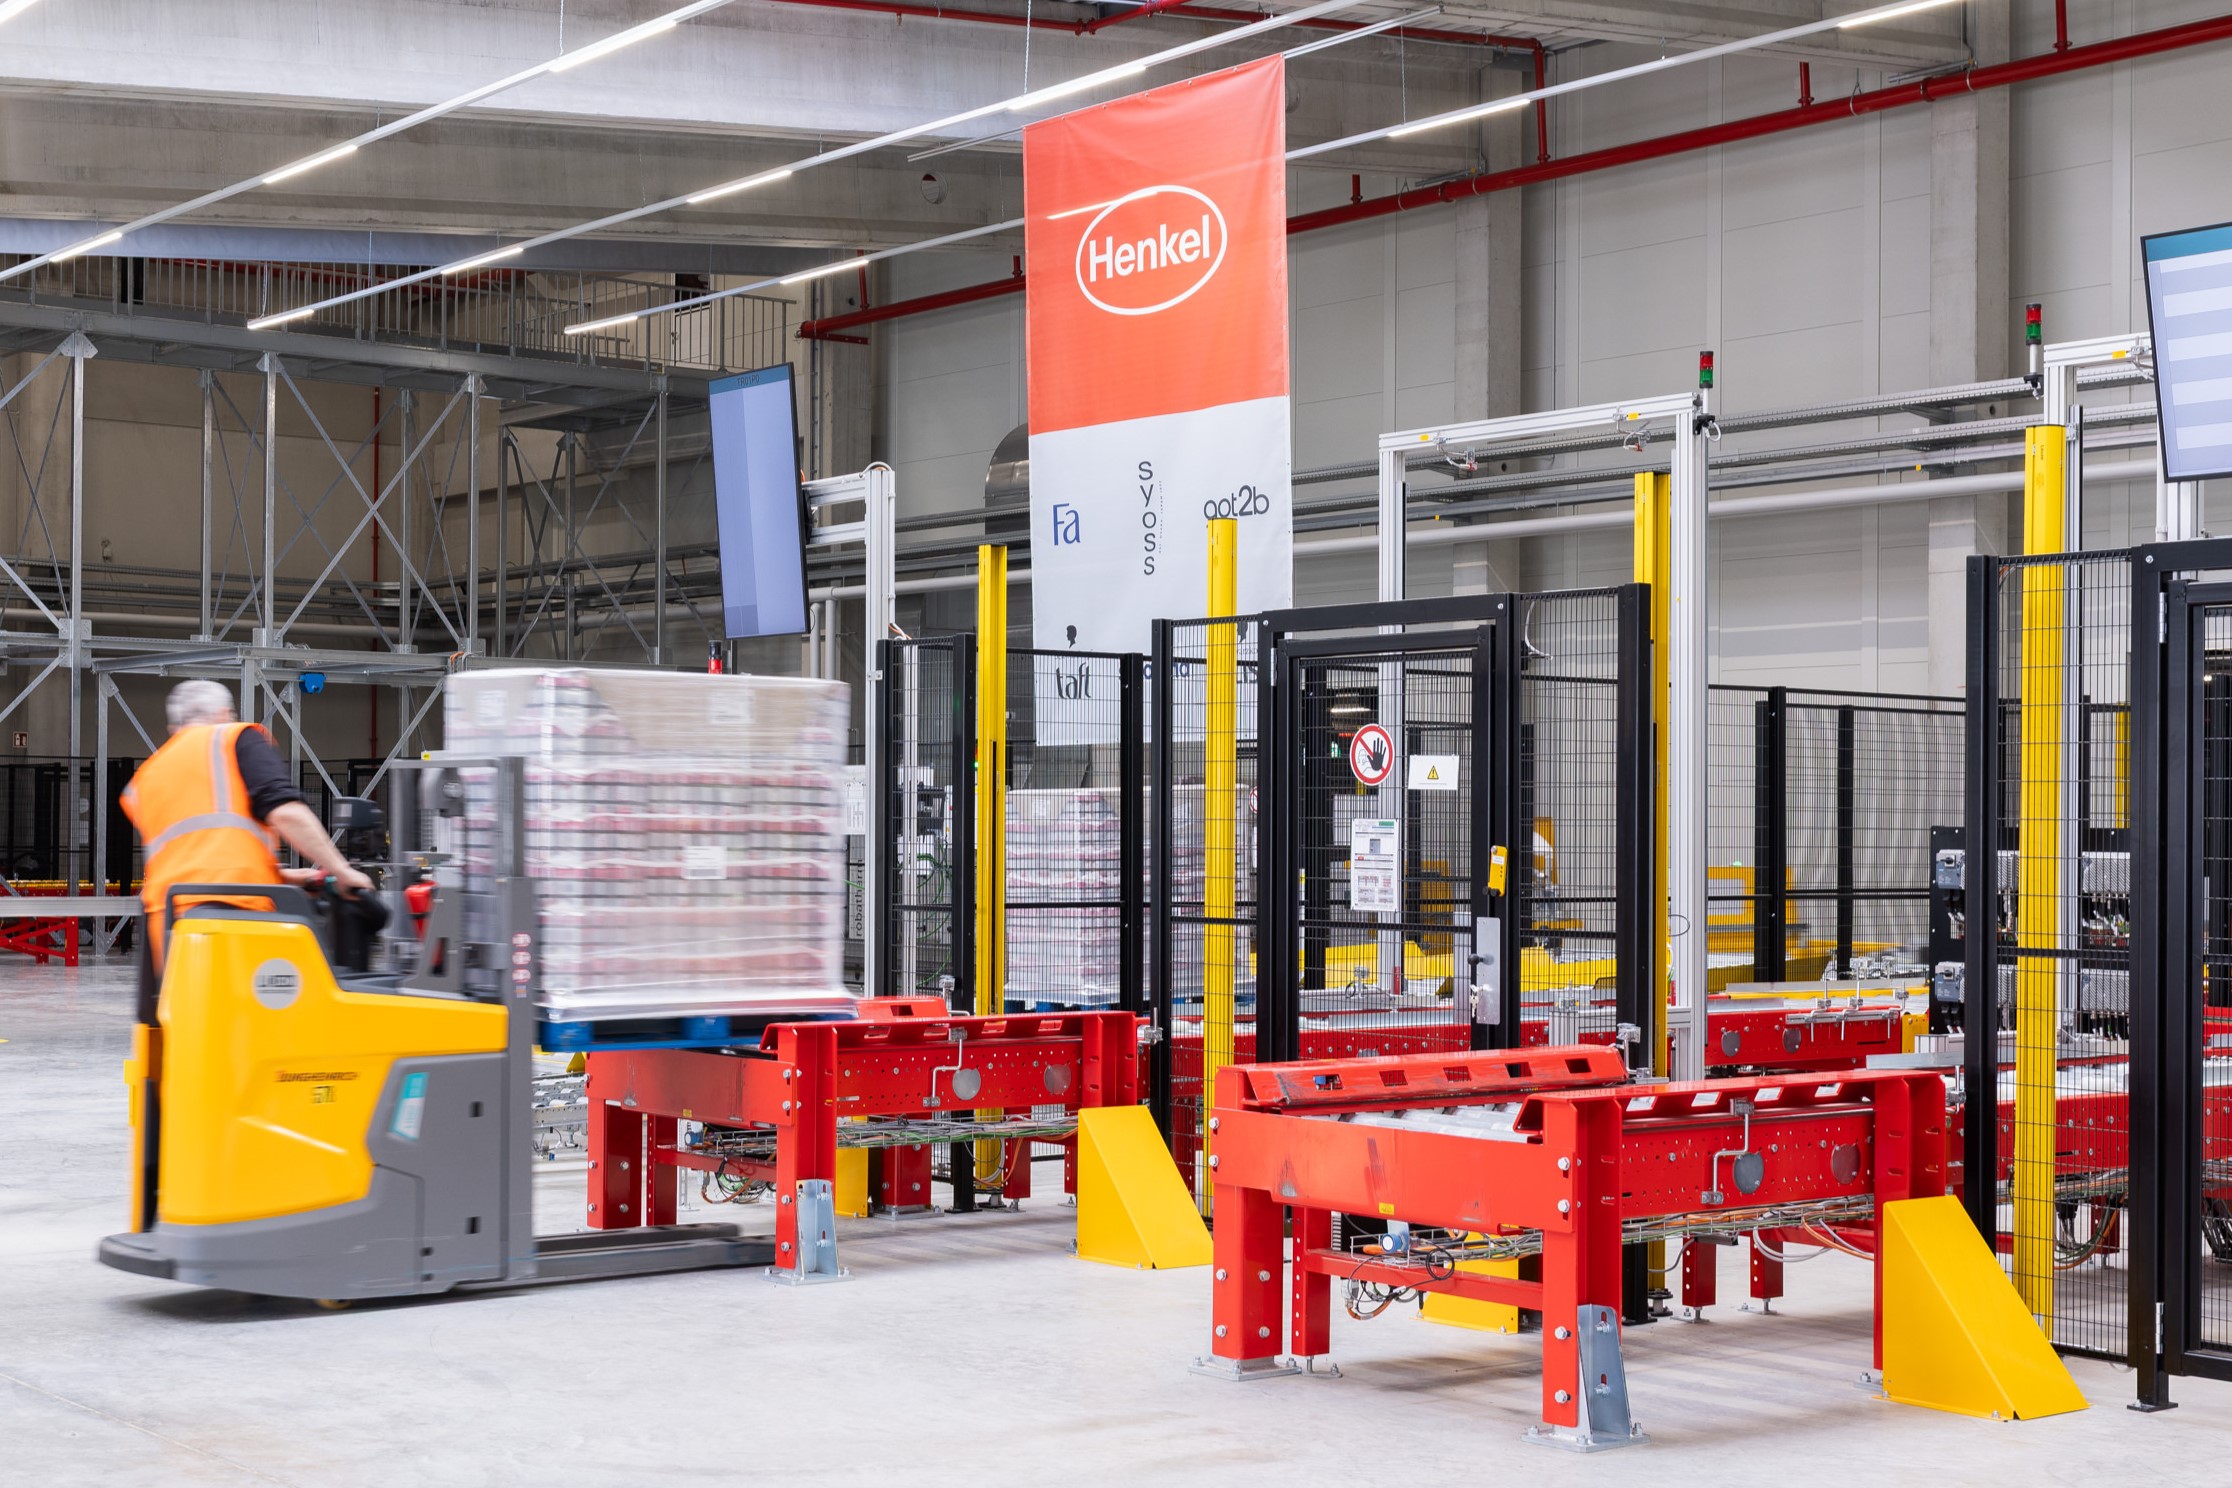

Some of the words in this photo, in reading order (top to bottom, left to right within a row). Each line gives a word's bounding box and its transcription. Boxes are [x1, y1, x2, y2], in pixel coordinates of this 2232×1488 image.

[1089, 214, 1210, 283] Henkel
[1053, 502, 1081, 546] Fa
[1056, 661, 1091, 700] taft
